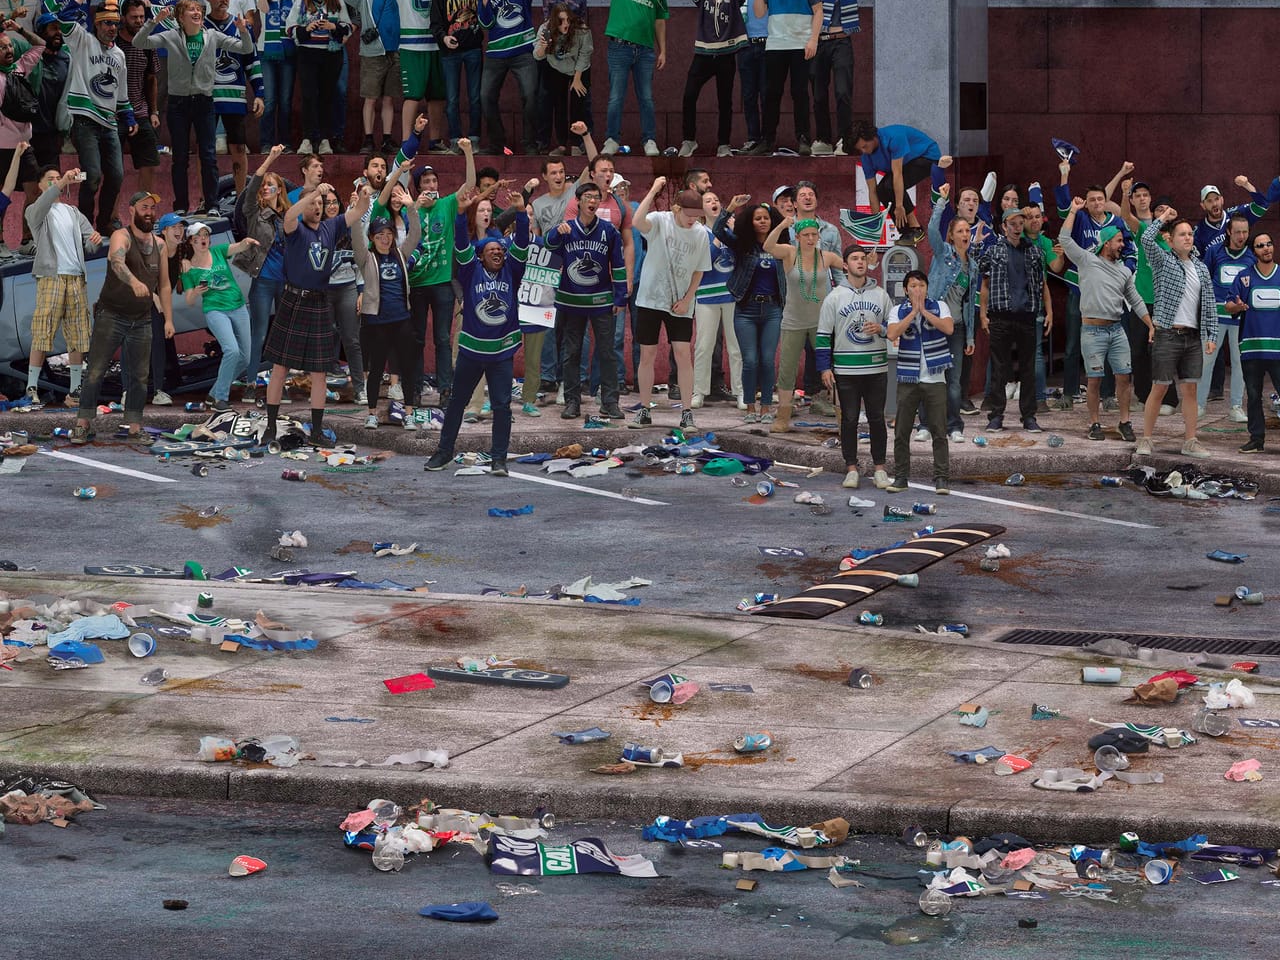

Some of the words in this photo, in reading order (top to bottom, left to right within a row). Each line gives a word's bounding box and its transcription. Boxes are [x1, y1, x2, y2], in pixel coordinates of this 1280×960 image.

[600, 230, 607, 242] A
[526, 244, 552, 266] GO
[564, 240, 609, 256] VANCOUVER
[524, 266, 560, 287] NUCKS
[518, 284, 543, 305] GO
[841, 301, 881, 317] VANCOUVER
